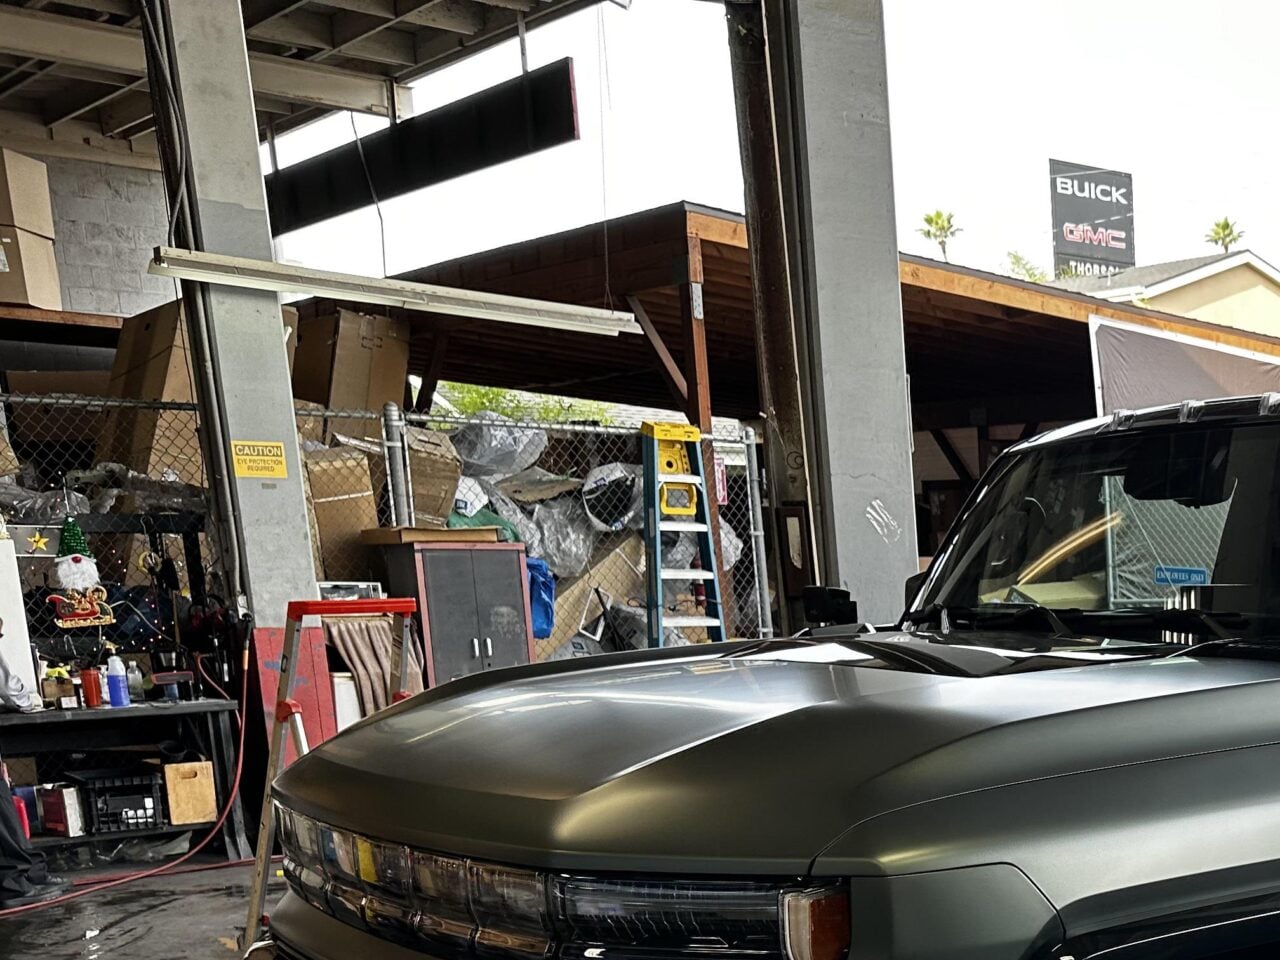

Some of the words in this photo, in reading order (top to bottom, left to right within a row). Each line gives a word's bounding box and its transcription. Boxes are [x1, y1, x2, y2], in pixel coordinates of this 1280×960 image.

[1056, 177, 1128, 204] BUICK
[1063, 222, 1126, 249] GMC
[236, 446, 281, 456] CAUTION
